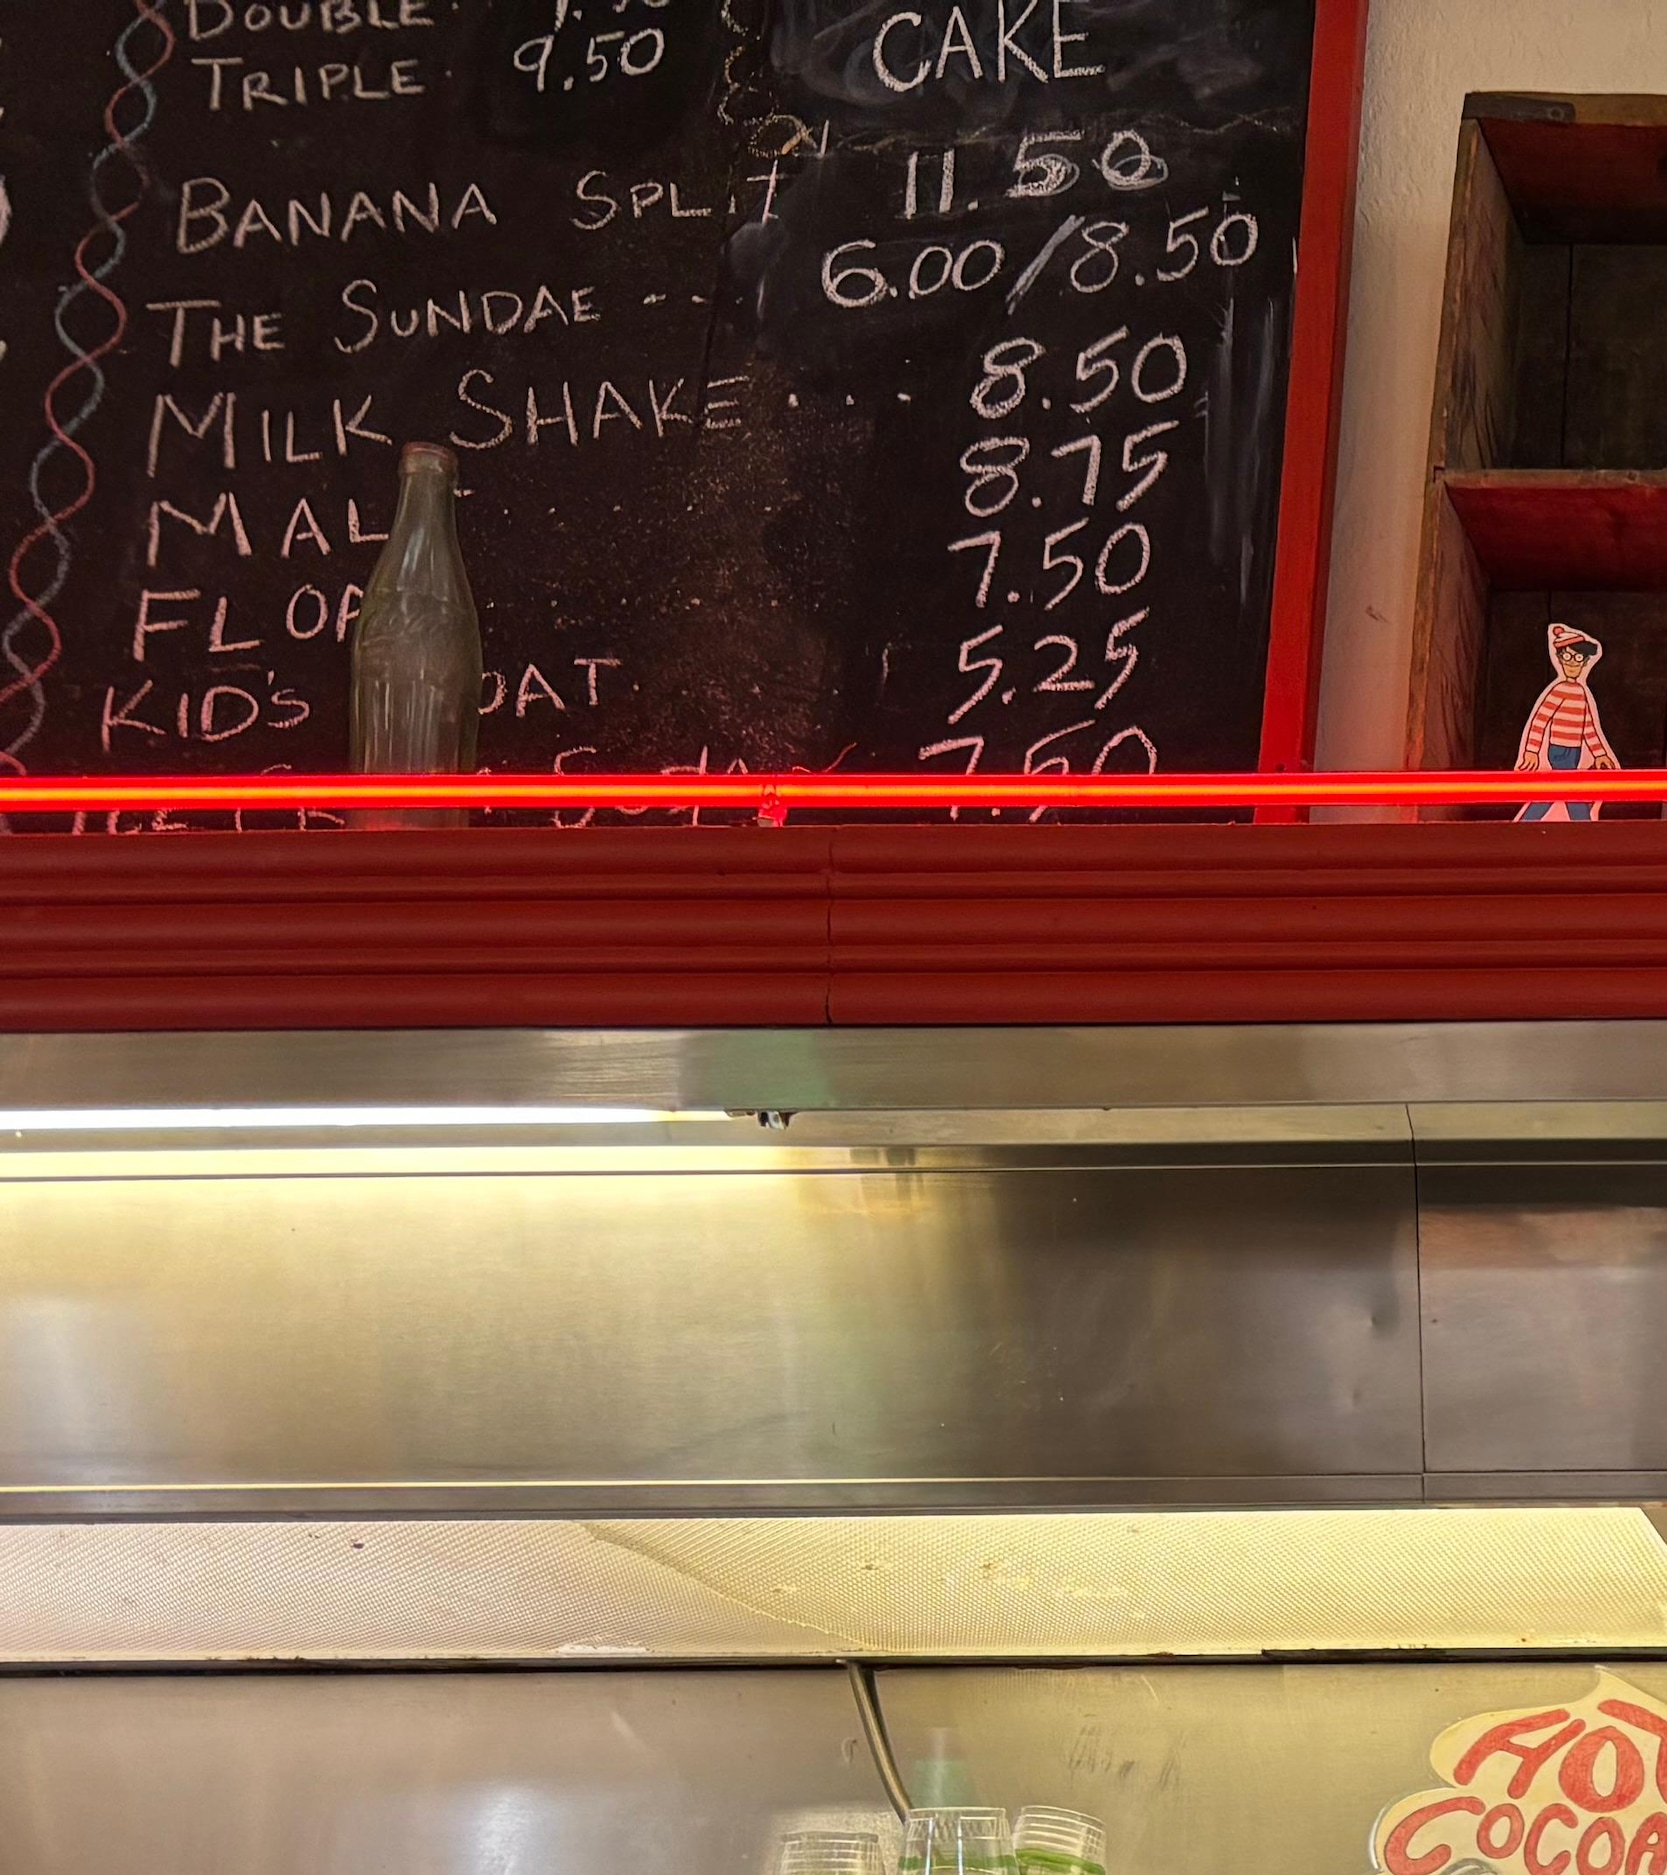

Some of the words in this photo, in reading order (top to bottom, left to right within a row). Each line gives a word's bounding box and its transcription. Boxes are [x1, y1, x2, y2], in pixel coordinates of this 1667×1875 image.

[188, 0, 434, 41] DOUBLE
[871, 0, 1106, 92] CAKE
[190, 56, 426, 111] TRIPLE
[512, 27, 665, 92] 9.50
[177, 176, 498, 255] BANANA
[571, 157, 790, 229] SPLIT
[904, 129, 1168, 220] 11.50
[147, 299, 286, 367] THE
[334, 279, 600, 354] SUNDAE
[146, 391, 392, 478] MILK
[449, 369, 750, 450] SHAKE
[970, 326, 1188, 421] 8.50
[959, 420, 1180, 518] 8.75
[948, 518, 1151, 610] 7.50
[101, 671, 310, 752] KID'S
[947, 607, 1150, 725] 5.25
